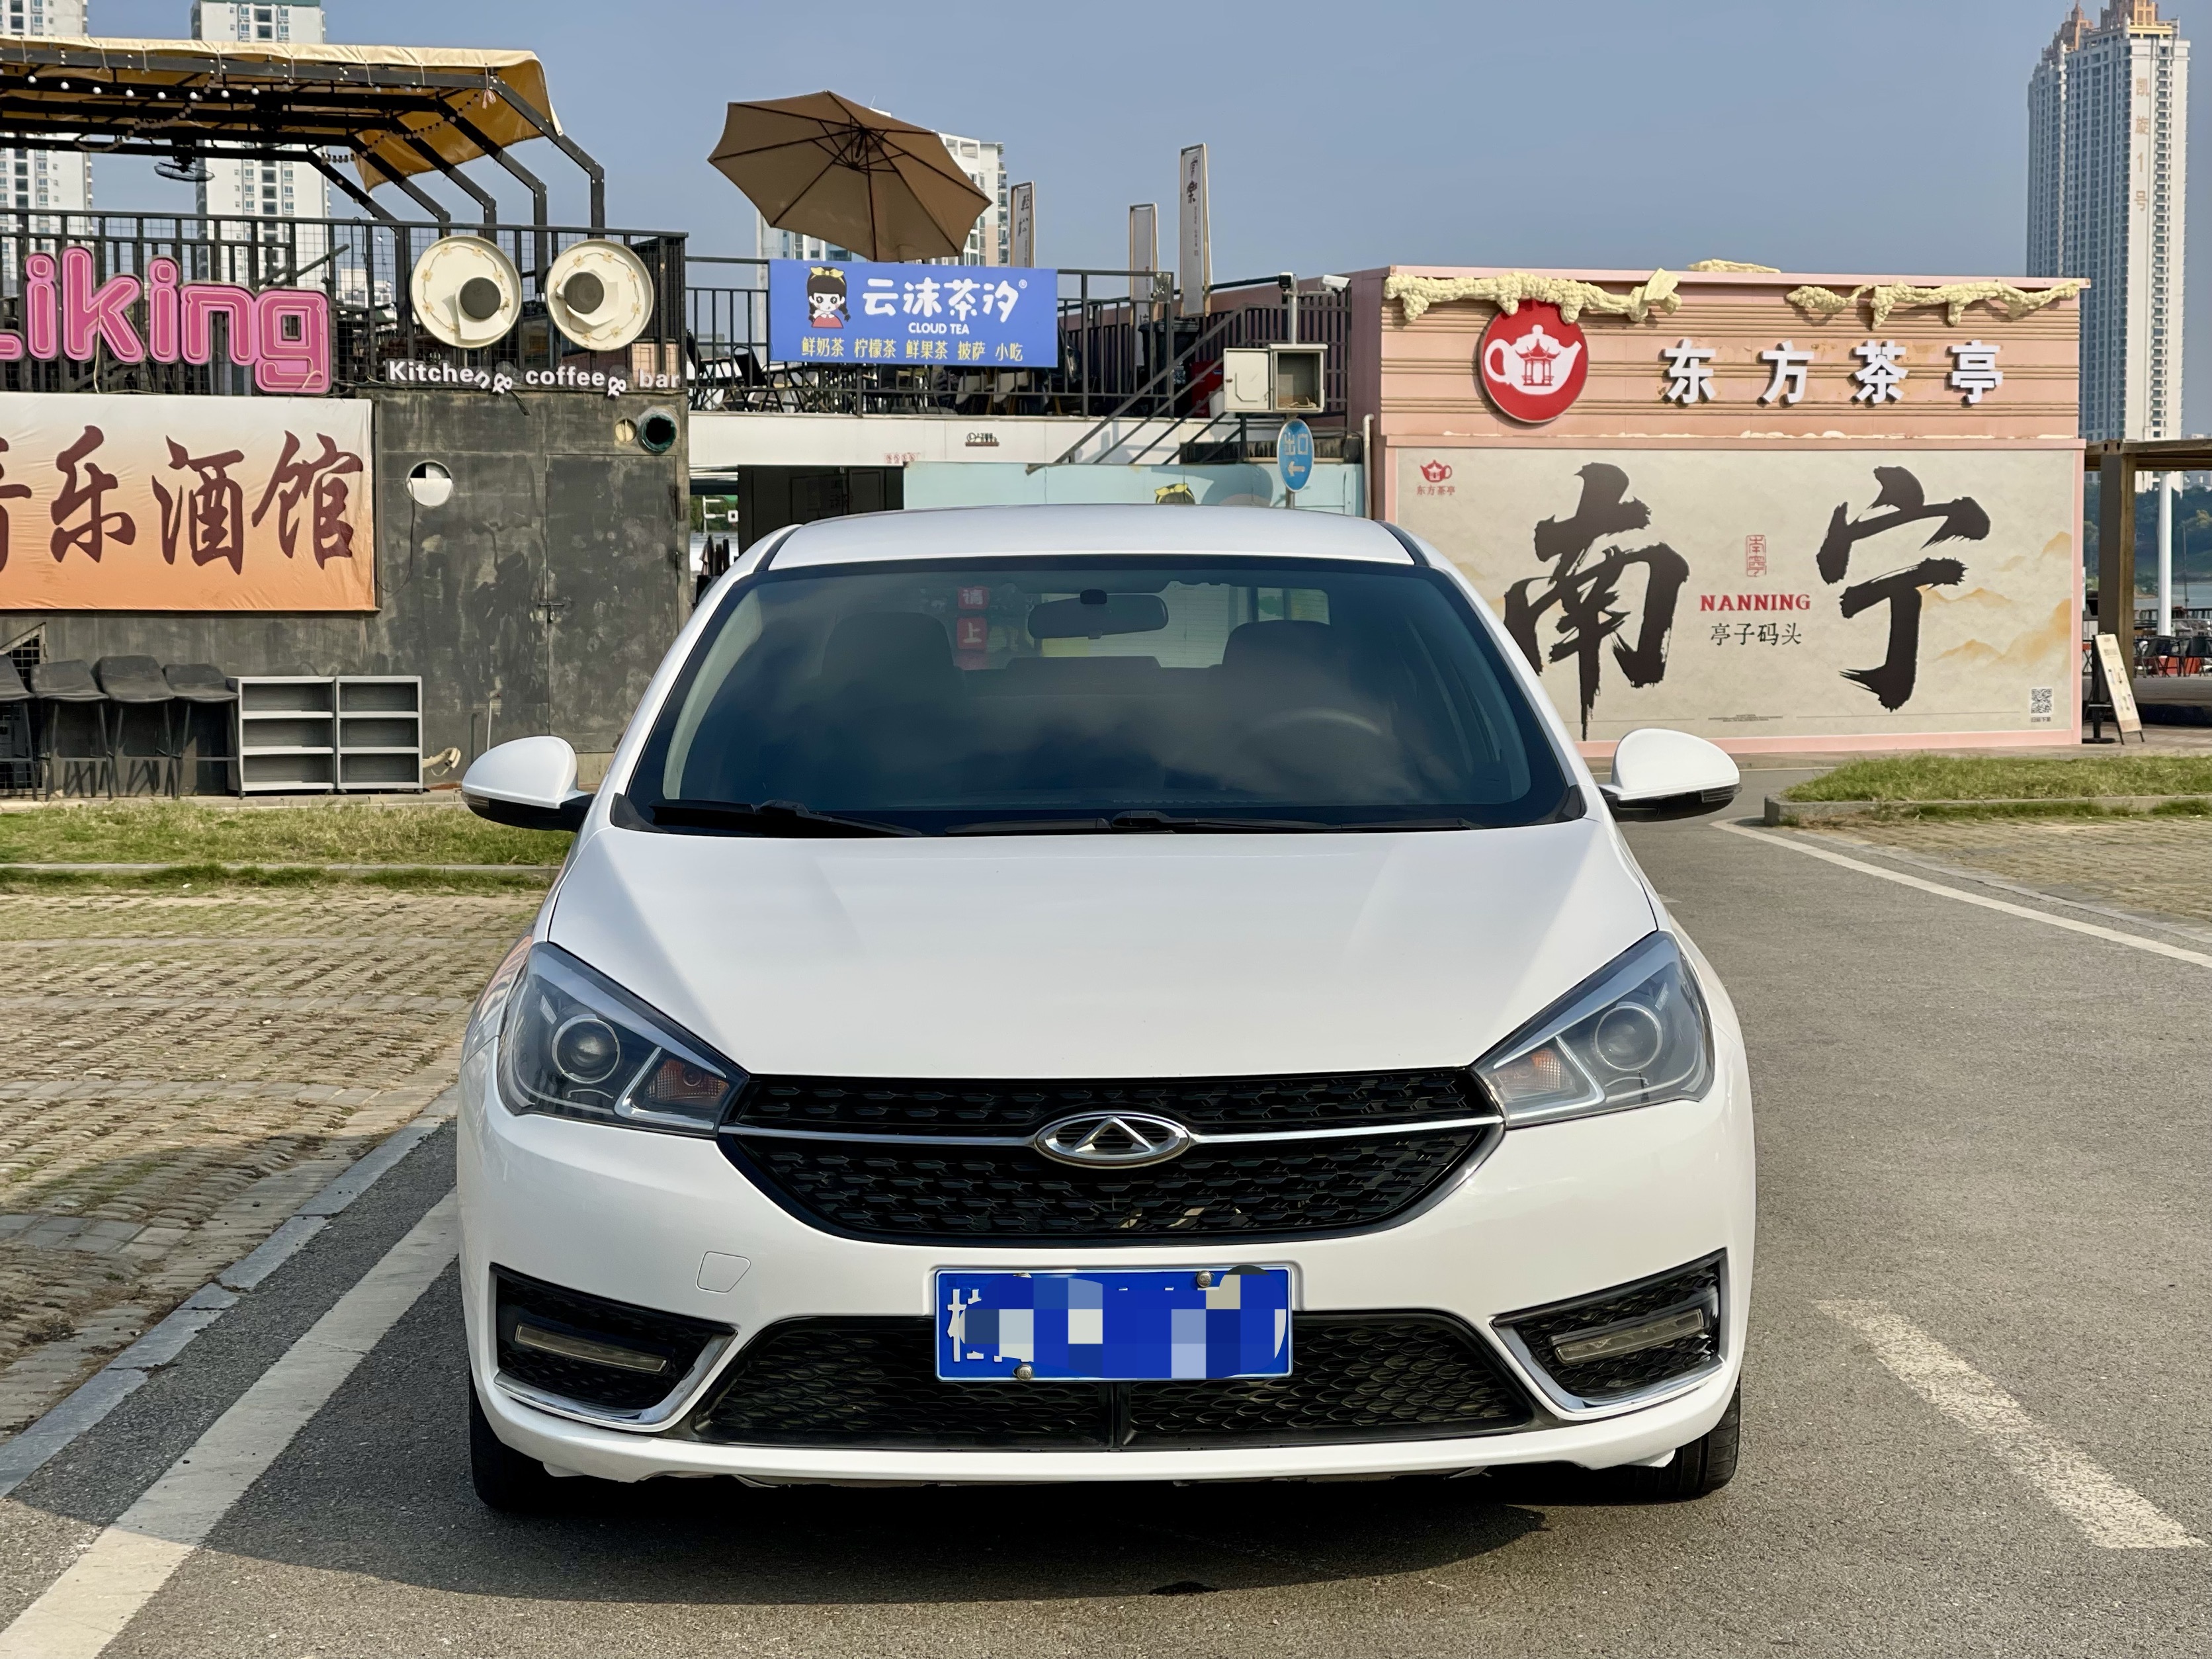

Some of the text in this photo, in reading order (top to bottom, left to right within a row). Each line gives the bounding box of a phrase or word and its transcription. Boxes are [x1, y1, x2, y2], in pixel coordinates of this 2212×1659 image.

[2135, 77, 2150, 212] 凯旋1号
[0, 246, 331, 394] iking
[908, 322, 970, 335] CLOUD TEA
[801, 336, 1023, 362] 鲜奶茶 柠檬茶 鲜果茶 披萨 小吃
[388, 360, 489, 389] Kitchen
[525, 365, 606, 386] coffee
[638, 368, 680, 388] bar
[1662, 339, 2004, 404] 东方茶亭
[1284, 431, 1309, 456] 出口
[1417, 485, 1455, 496] 东方茶亭
[1700, 594, 1811, 612] NANNING
[1711, 622, 1802, 646] 亭子码头
